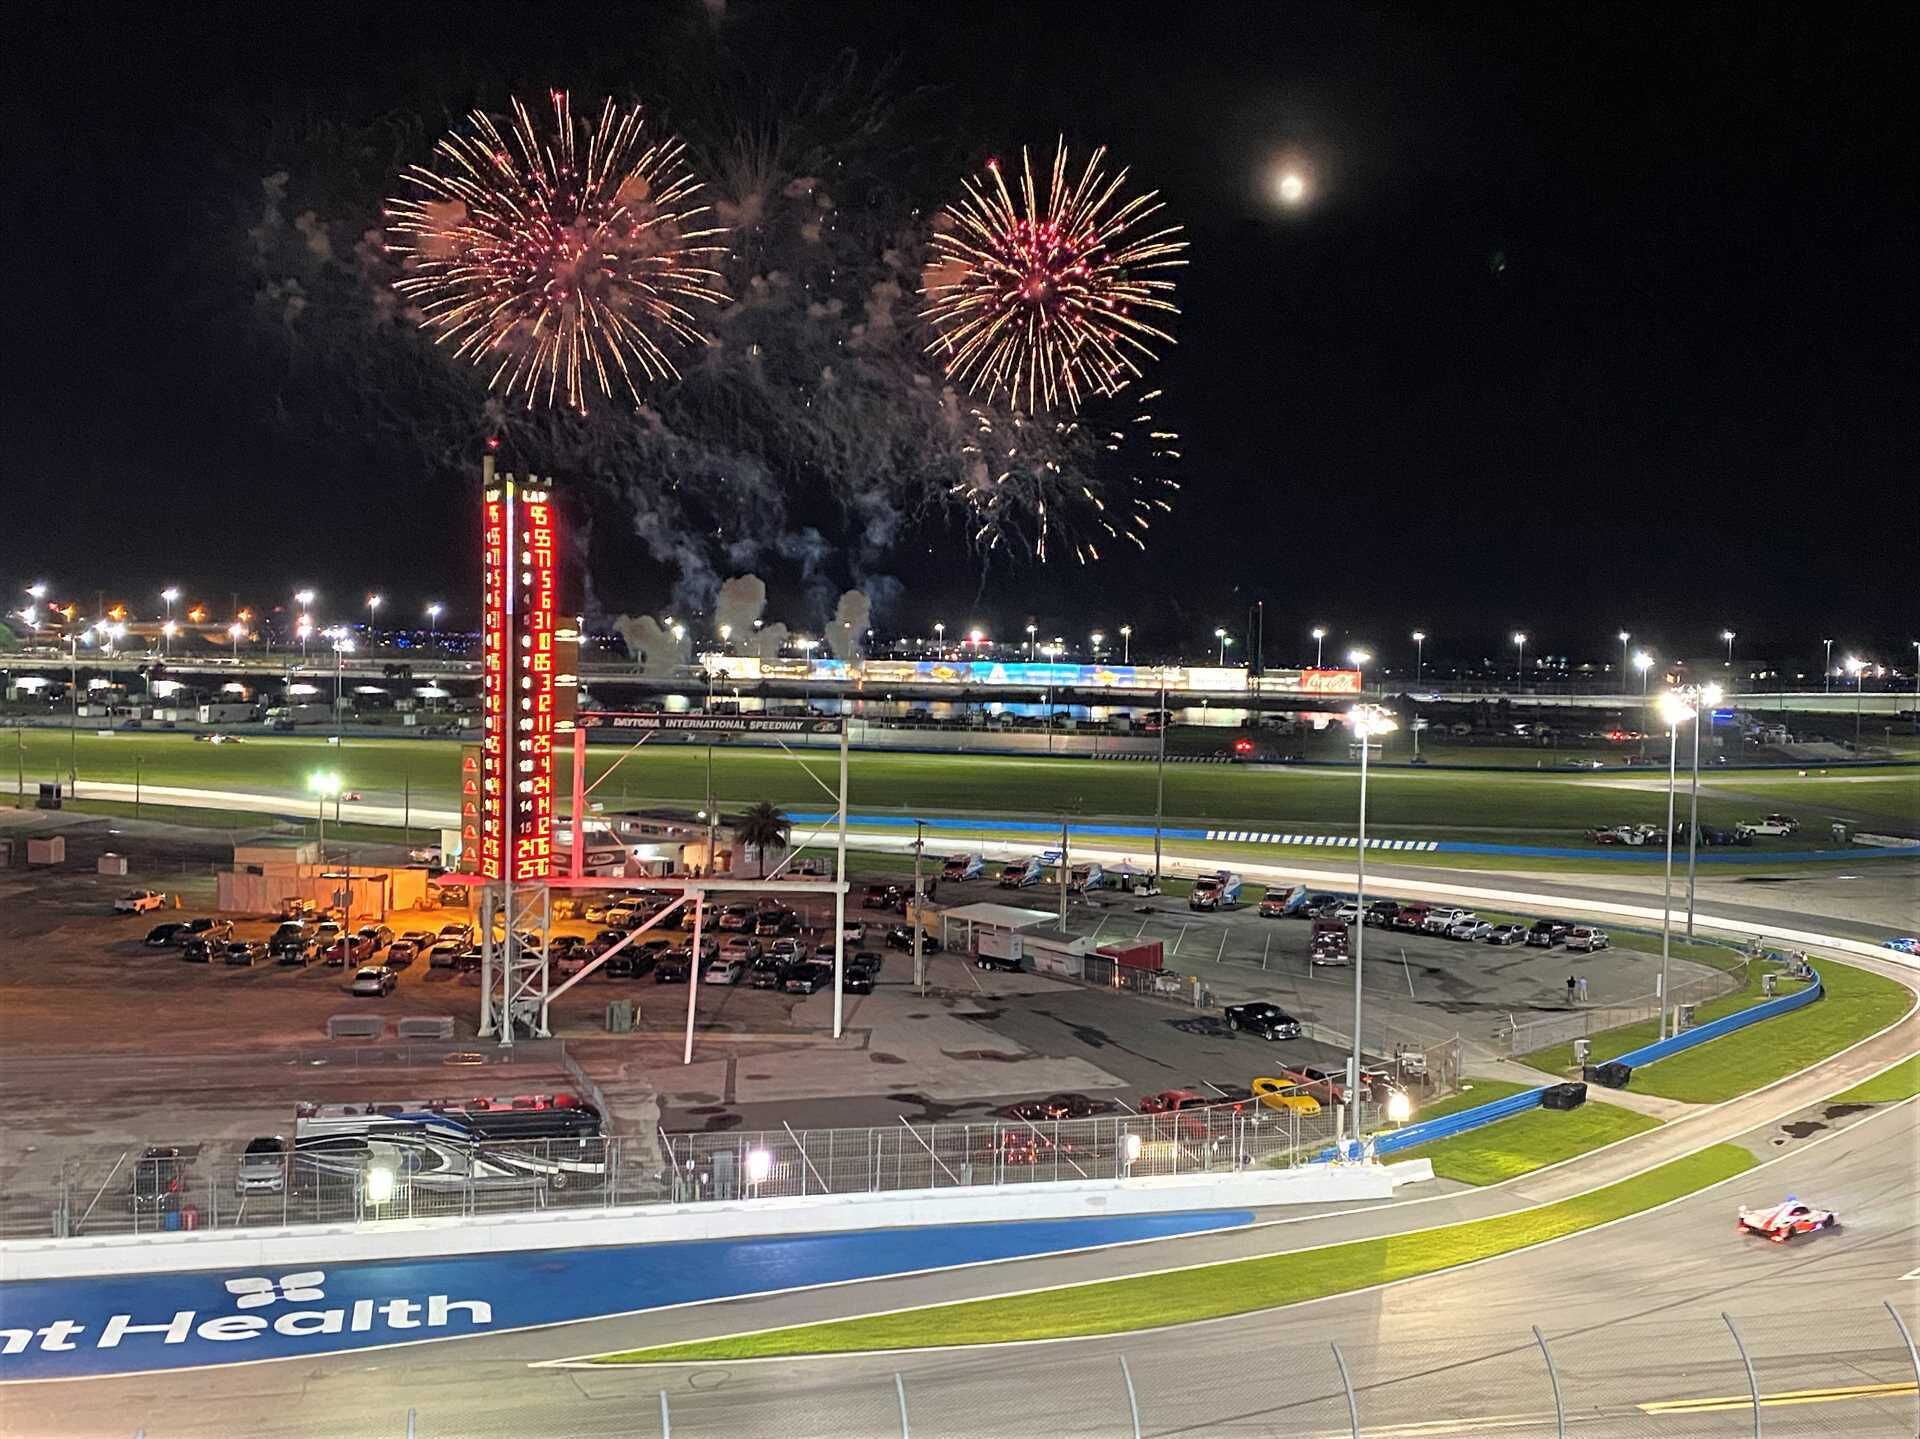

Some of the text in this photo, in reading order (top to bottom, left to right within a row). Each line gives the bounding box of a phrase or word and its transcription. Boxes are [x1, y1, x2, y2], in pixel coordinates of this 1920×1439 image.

[542, 570, 551, 588] 5
[534, 611, 551, 629] 31
[541, 674, 551, 691] 3
[538, 714, 551, 732] 11
[613, 718, 660, 727] DAYTONA
[665, 719, 746, 729] INTERNATIONAL
[750, 721, 804, 730] SPEEDWAY
[541, 756, 550, 773] 4
[97, 1295, 492, 1349] Health
